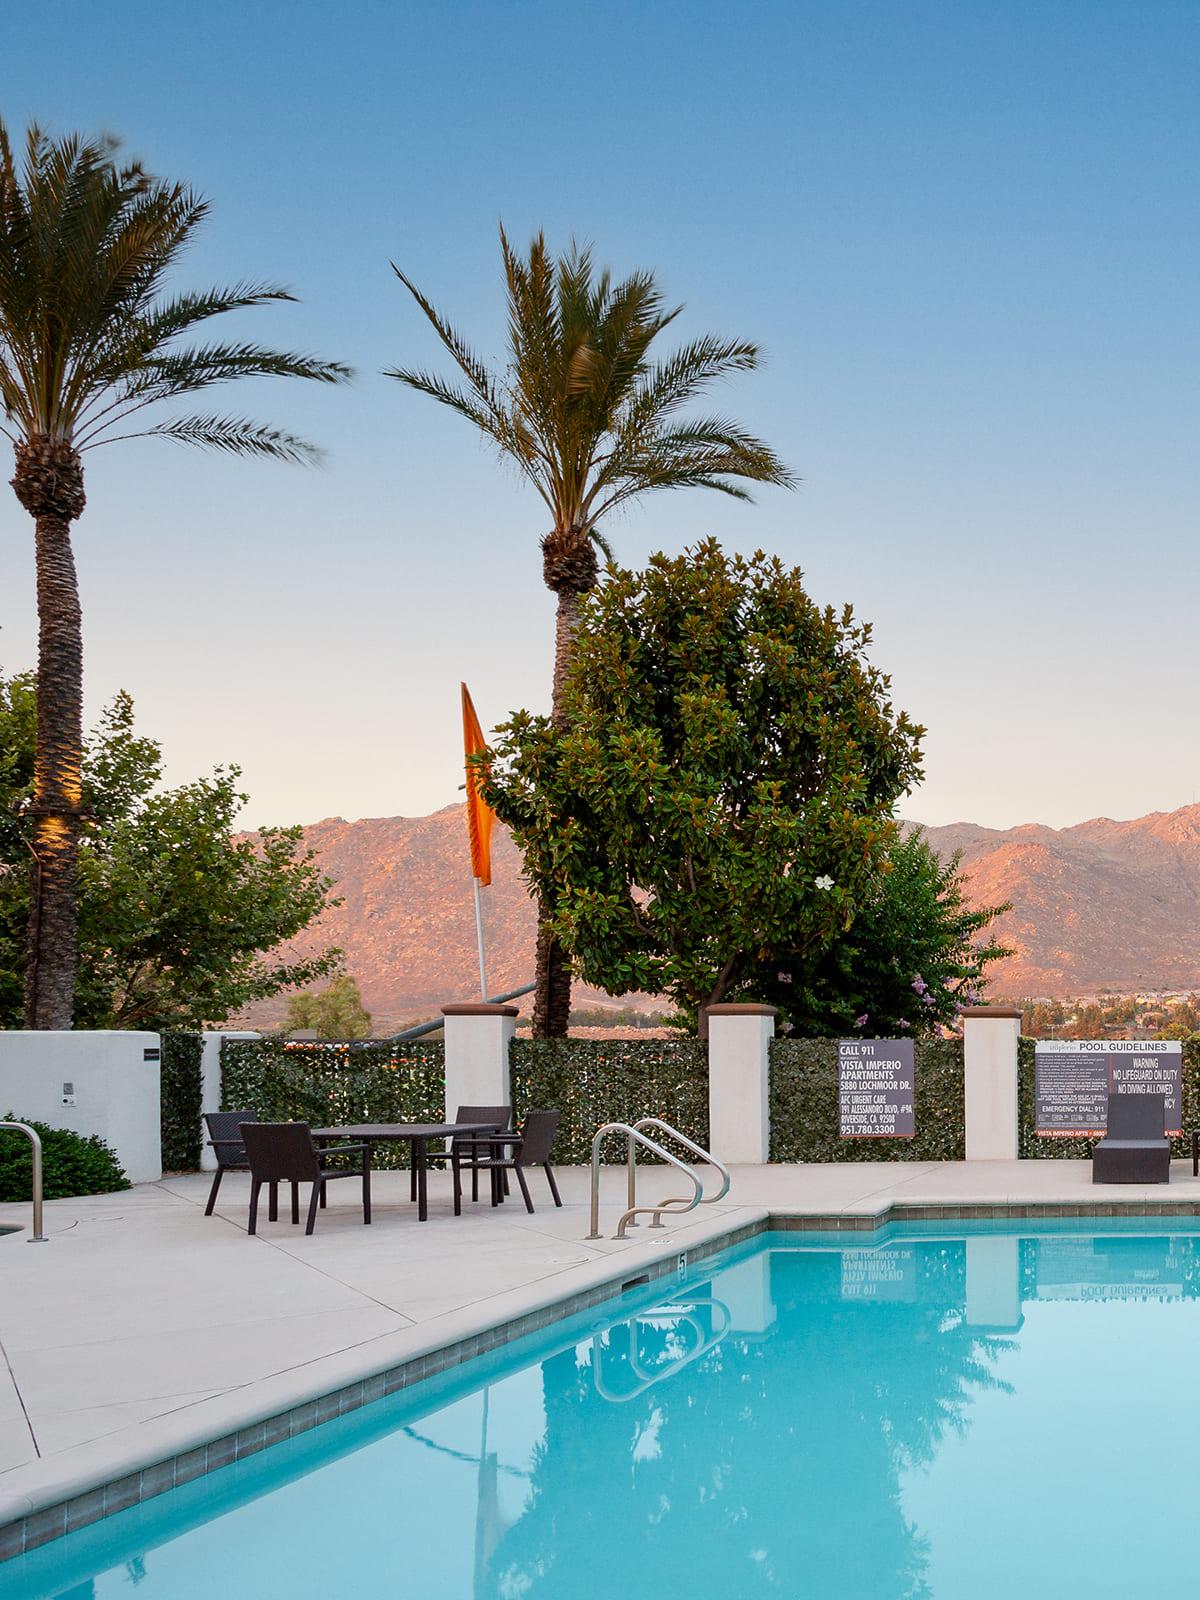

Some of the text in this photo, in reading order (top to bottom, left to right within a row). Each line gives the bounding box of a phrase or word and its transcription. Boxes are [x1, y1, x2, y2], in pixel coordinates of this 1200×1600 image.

[840, 1046, 875, 1055] CALL 911
[1079, 1043, 1167, 1051] POOL GUIDELINES
[840, 1060, 901, 1070] VISTA IMPERIO
[1132, 1058, 1158, 1068] WARNING
[840, 1070, 894, 1080] APARTMENTS
[1113, 1070, 1178, 1080] NO LIFEGUARD ON DUTY
[840, 1081, 912, 1090] 5880 LOCHMOOR DR.
[1117, 1084, 1174, 1095] NO DIVING ALLOWED
[841, 1095, 887, 1104] AFC URGENT CARE
[869, 1115, 878, 1124] CA
[841, 1125, 895, 1134] 951.780.3300
